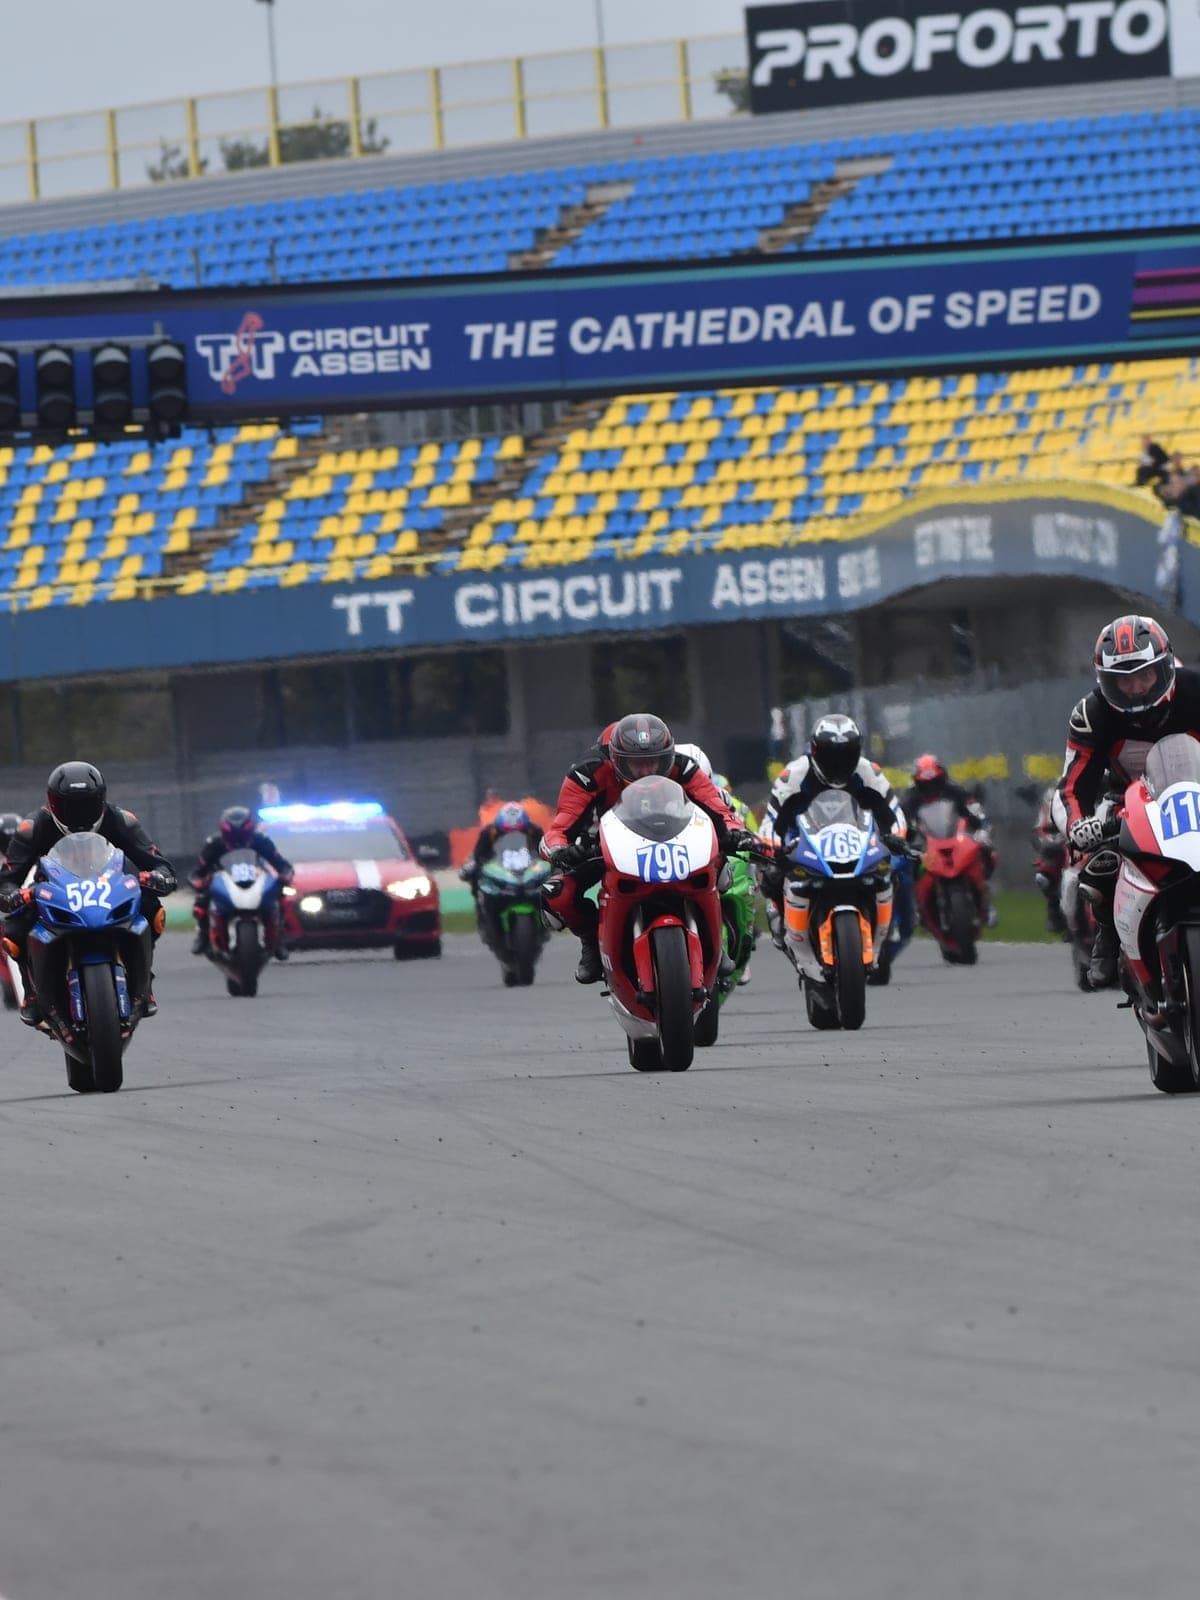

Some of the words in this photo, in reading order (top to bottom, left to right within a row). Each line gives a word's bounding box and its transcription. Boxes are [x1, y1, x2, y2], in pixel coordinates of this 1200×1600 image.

[753, 0, 1167, 86] PROFORTO
[289, 323, 430, 352] CIRCUIT
[464, 319, 558, 361] THE
[569, 300, 856, 355] CATHEDRAL
[868, 294, 936, 334] OF
[944, 282, 1102, 330] SPEED
[291, 347, 431, 379] ASSEN
[331, 588, 414, 635] TT
[453, 568, 682, 628] CIRCUIT
[712, 554, 826, 609] ASSEN
[637, 843, 690, 882] 796
[821, 831, 862, 859] 765
[66, 880, 112, 912] 522
